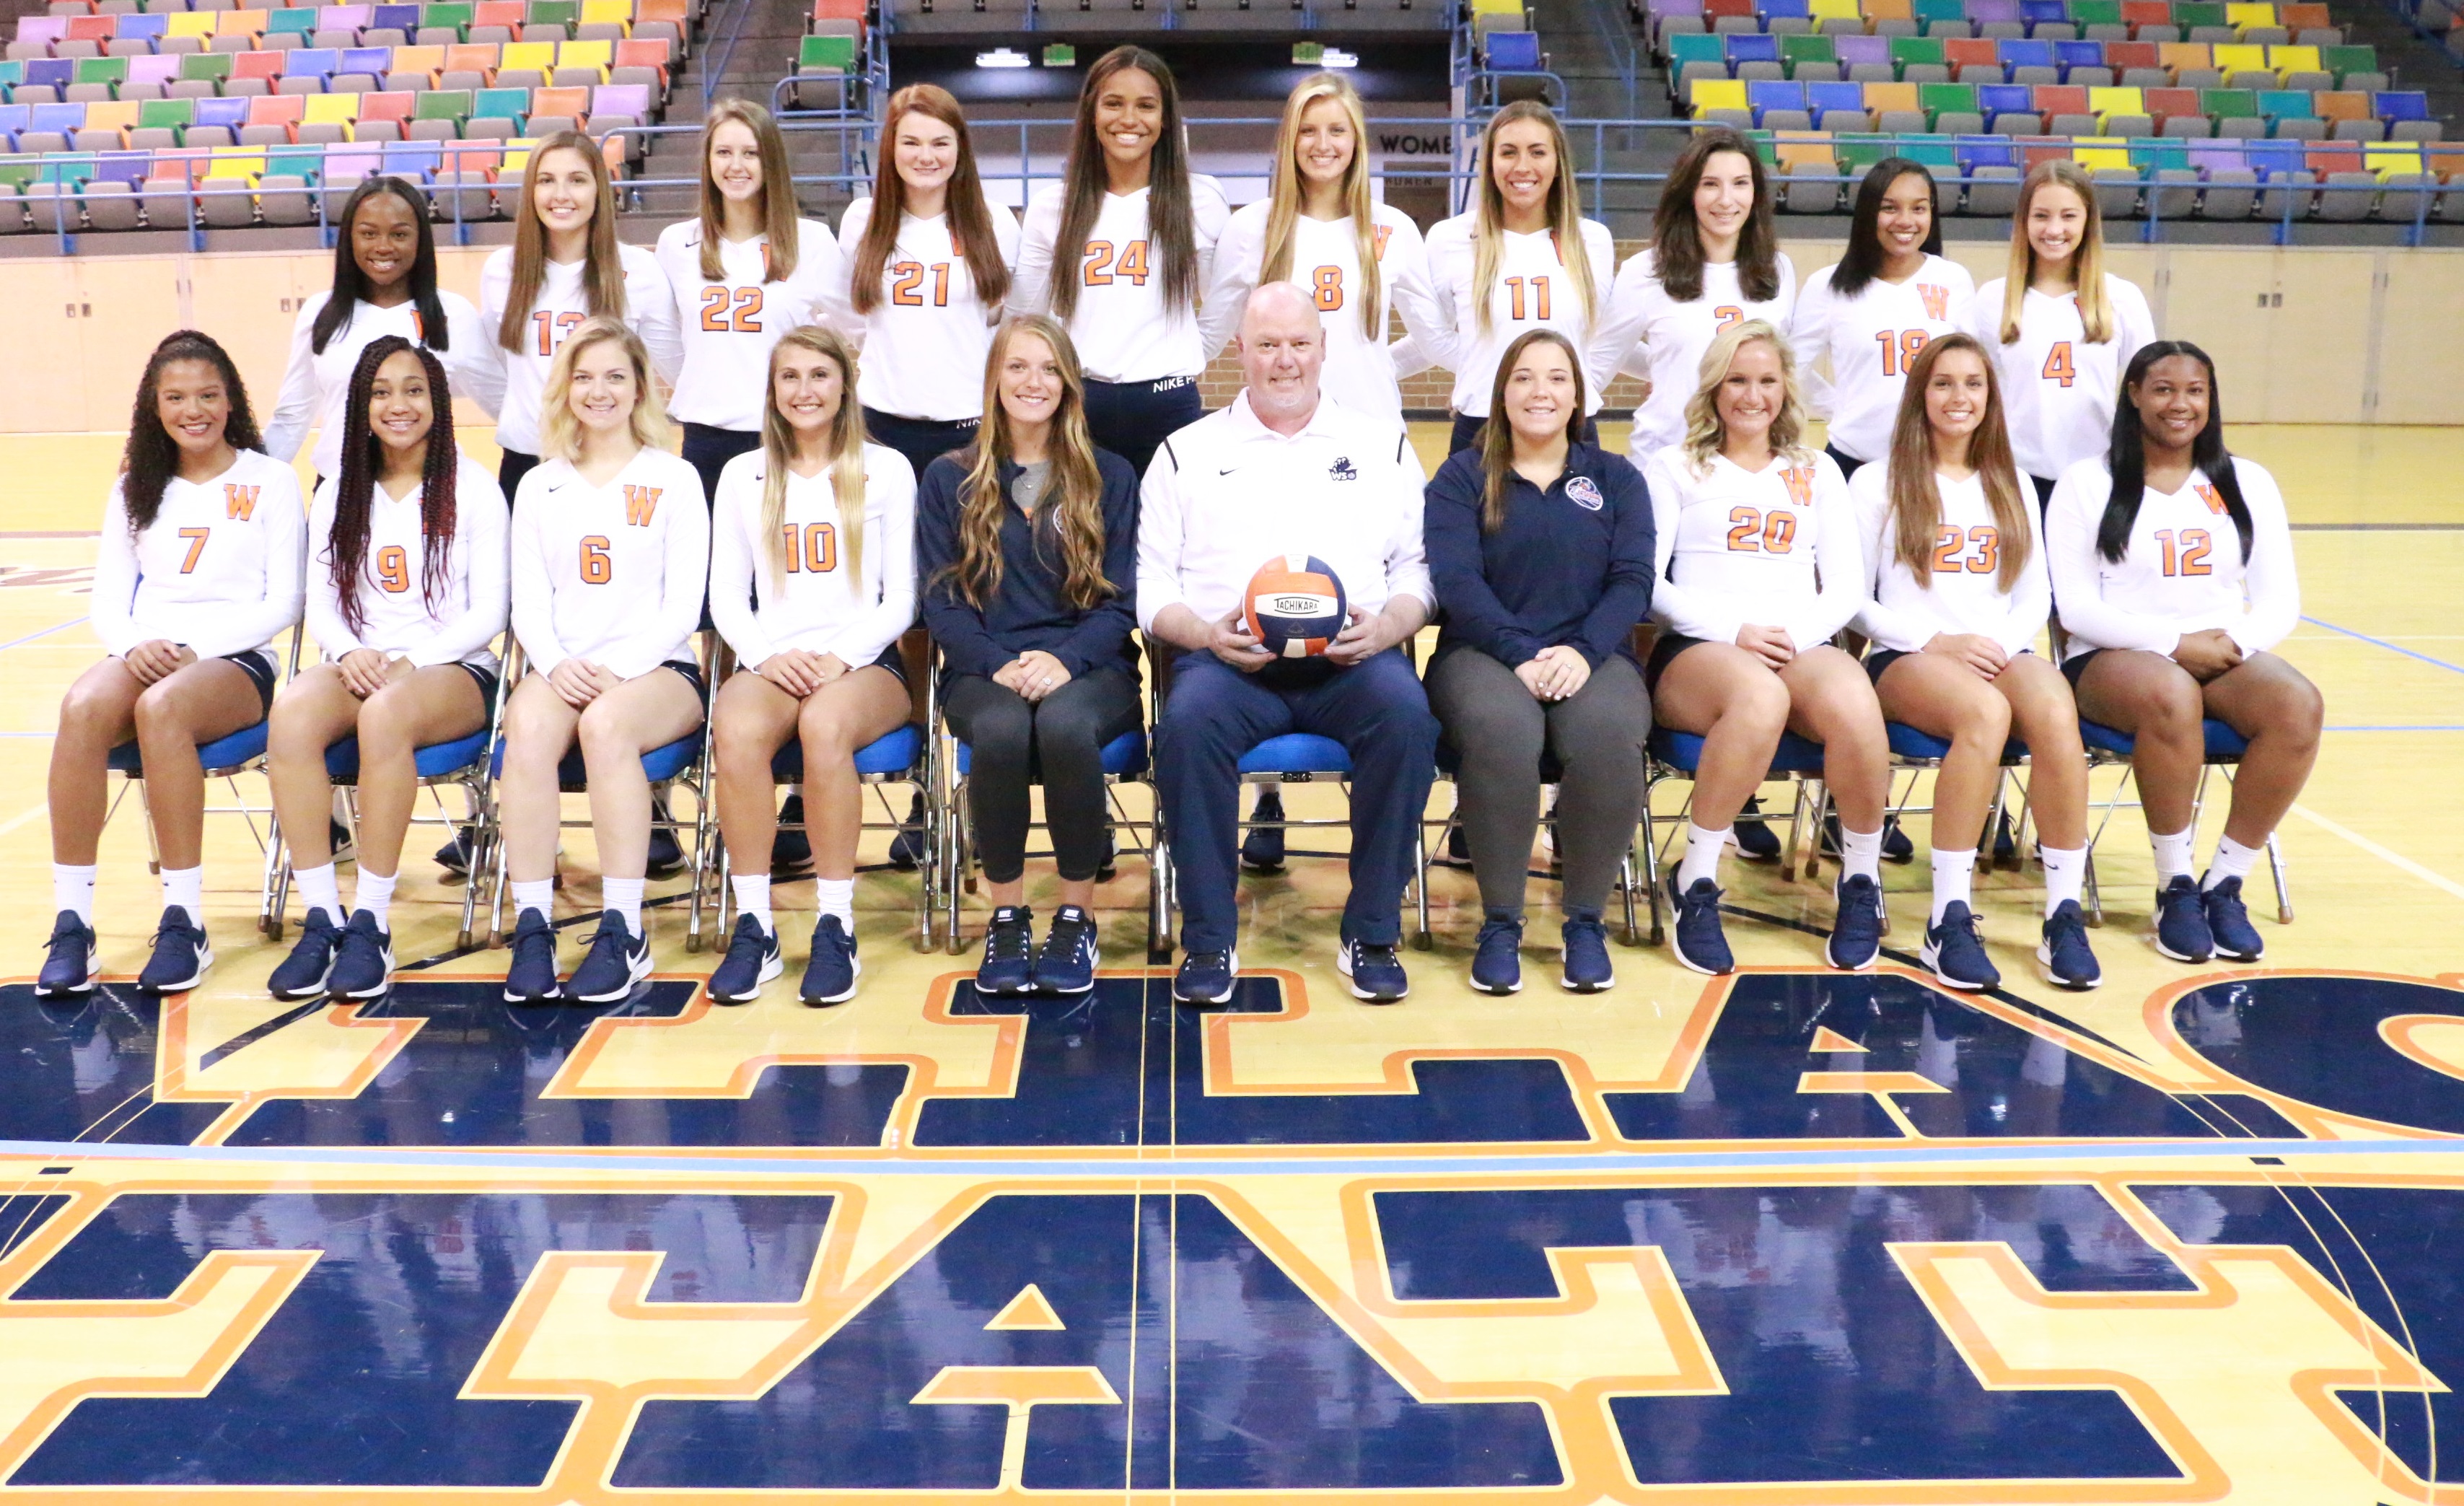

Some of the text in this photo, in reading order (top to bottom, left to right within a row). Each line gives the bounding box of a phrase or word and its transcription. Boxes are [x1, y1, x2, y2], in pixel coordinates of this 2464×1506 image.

[893, 261, 950, 307] 21
[1084, 241, 1149, 286] 24
[701, 286, 763, 333] 22
[1313, 266, 1343, 311] 8
[1505, 276, 1550, 320] 11
[1917, 284, 1949, 321] W
[1153, 377, 1184, 393] NIKE
[2042, 341, 2075, 388] 4
[224, 484, 260, 521] W
[623, 485, 662, 527] W
[1778, 468, 1815, 507] W
[179, 527, 210, 574] 7
[784, 522, 835, 573] 10
[1727, 506, 1796, 553] 20
[1934, 525, 1999, 574] 23
[377, 545, 409, 592] 9
[579, 535, 611, 585] 6
[2154, 529, 2212, 577] 12
[1273, 597, 1318, 612] TACHIKARA
